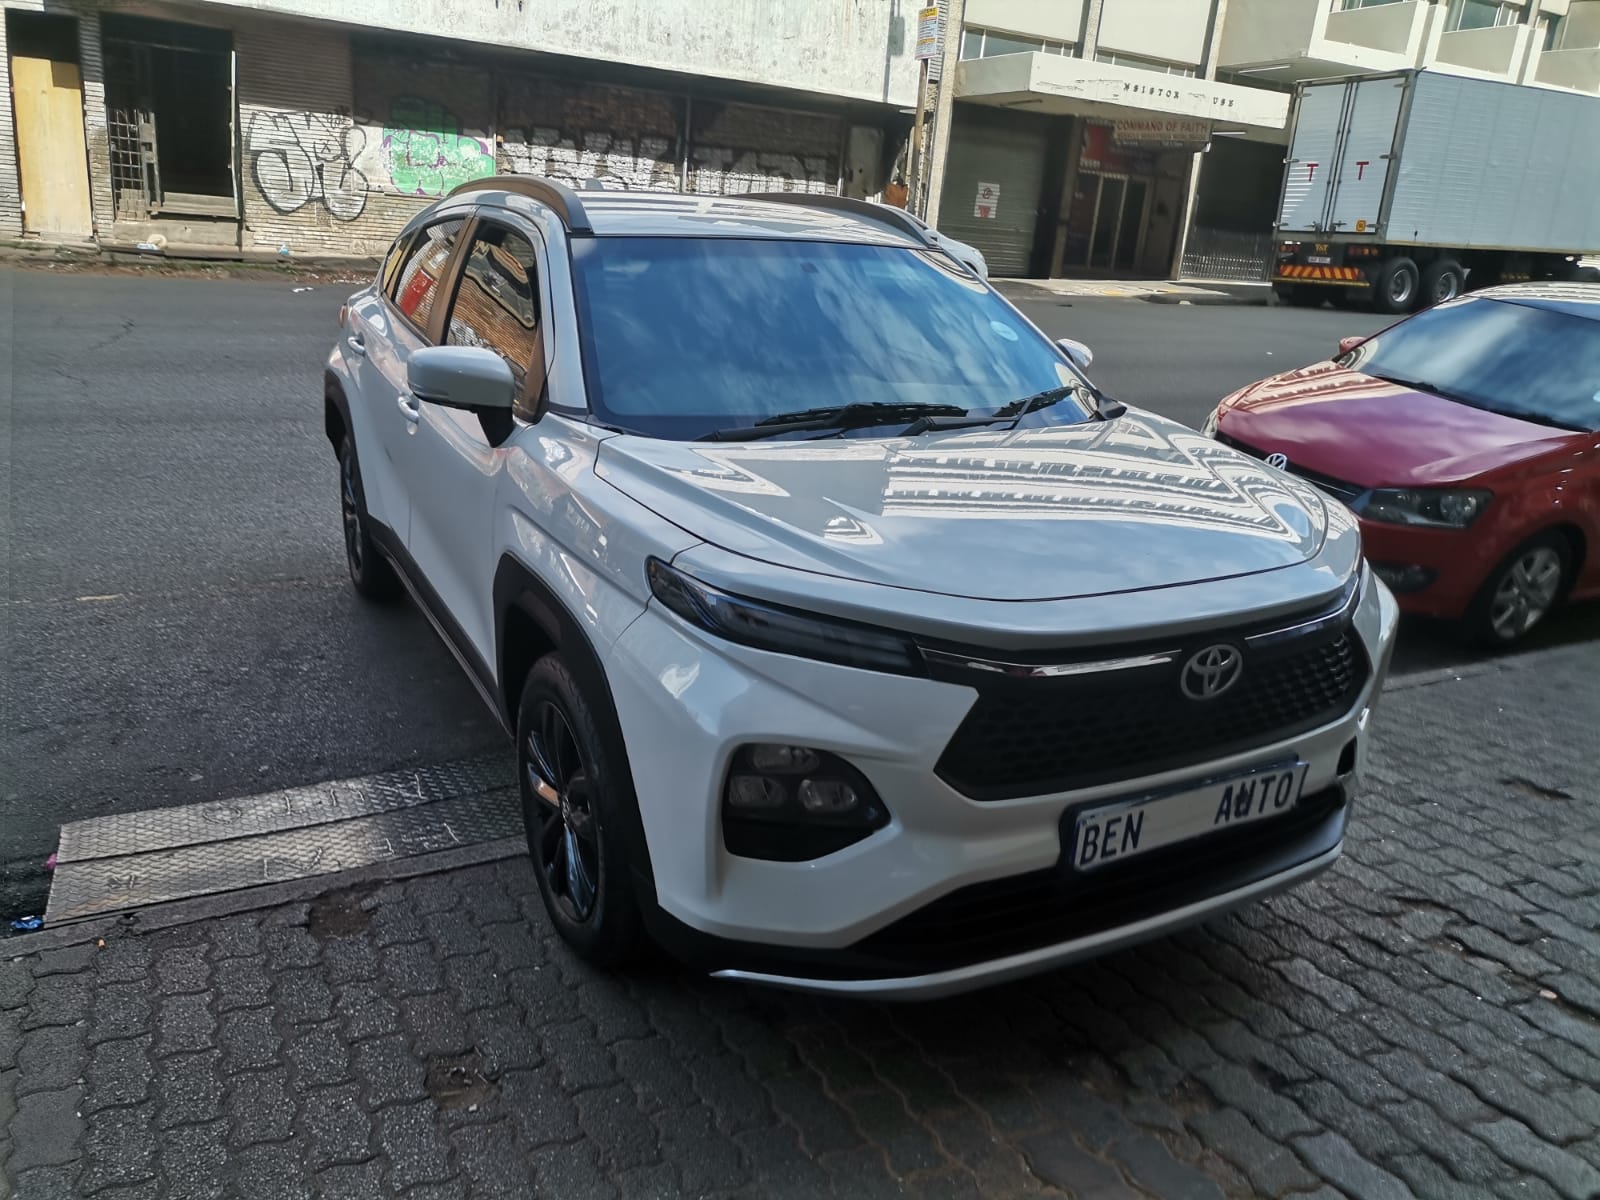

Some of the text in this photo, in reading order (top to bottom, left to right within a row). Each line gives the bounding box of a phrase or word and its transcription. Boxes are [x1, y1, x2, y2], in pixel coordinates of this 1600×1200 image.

[1117, 119, 1163, 131] COMMAND
[1166, 120, 1176, 131] OF
[1180, 121, 1208, 132] FAITH
[1079, 770, 1294, 866] BEN AUTO
